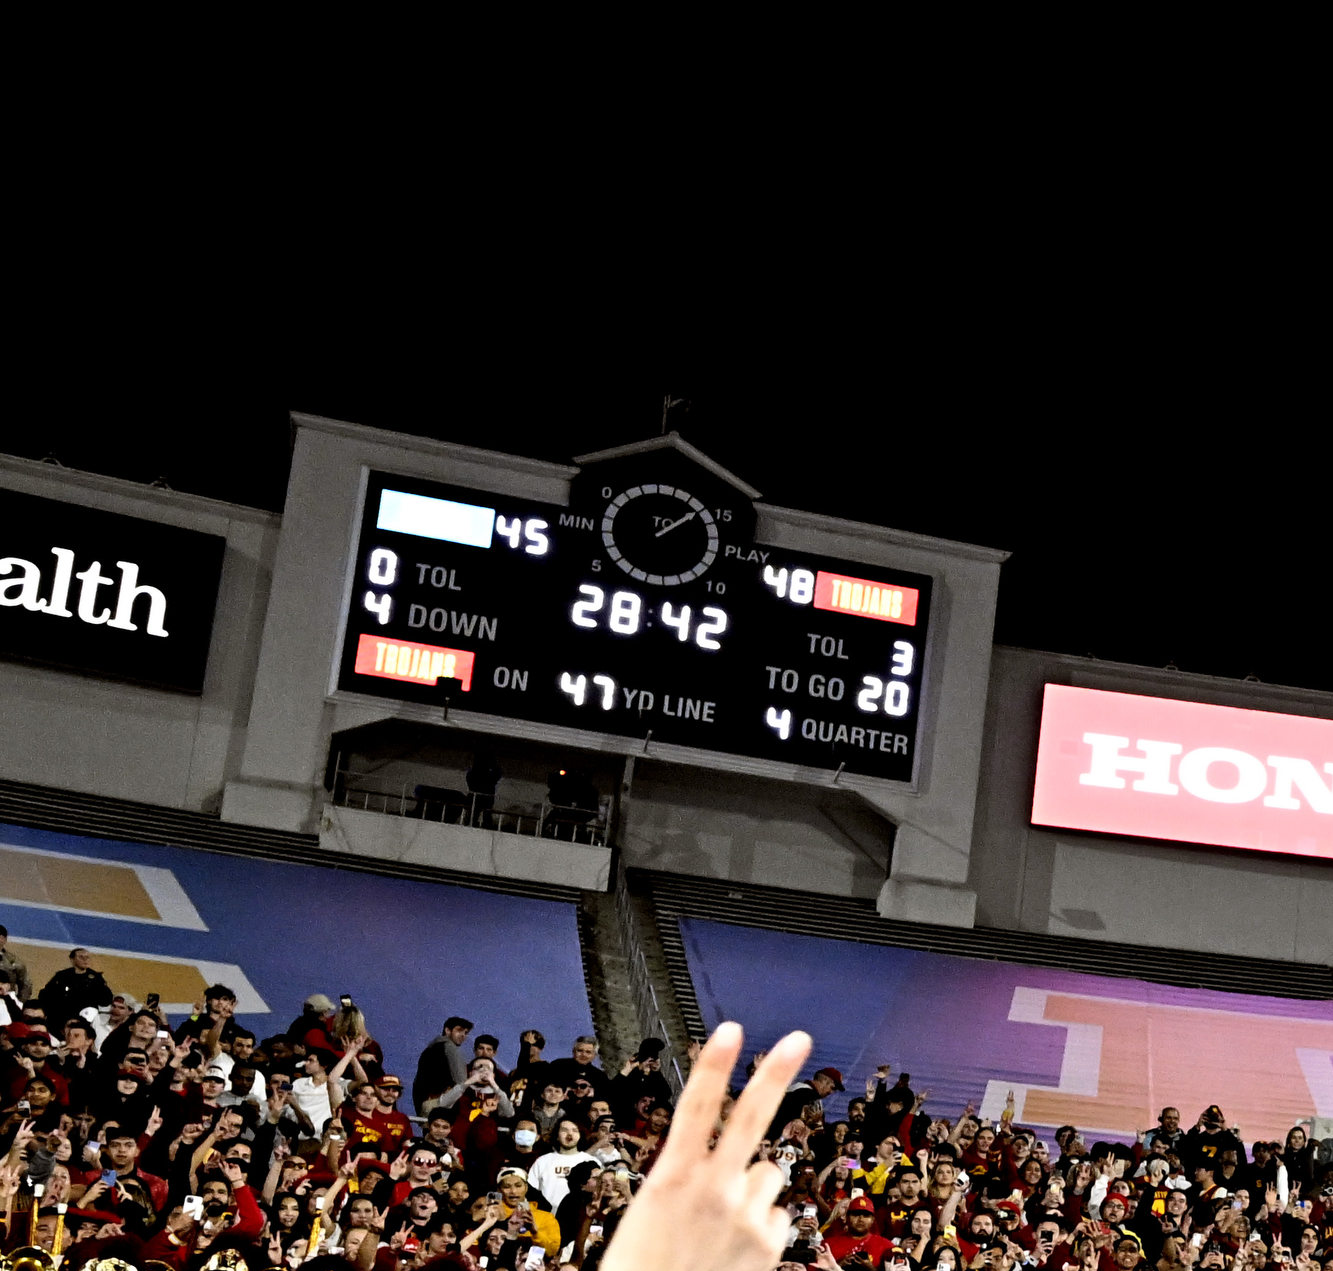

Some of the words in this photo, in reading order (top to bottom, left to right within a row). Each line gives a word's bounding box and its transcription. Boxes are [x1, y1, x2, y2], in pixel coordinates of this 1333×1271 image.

[496, 515, 549, 555] 45
[559, 513, 594, 531] MIN
[715, 508, 733, 522] 15
[368, 548, 398, 586] 0
[416, 563, 461, 591] TOL
[591, 559, 602, 572] 5
[724, 545, 770, 564] PLAY
[705, 580, 726, 594] 10
[763, 564, 814, 604] 48
[831, 578, 903, 618] TROJANS
[364, 591, 392, 625] 4
[407, 603, 498, 641] DOWN
[571, 584, 727, 650] 28:42
[807, 633, 849, 660] TOL
[891, 640, 914, 676] 3
[493, 666, 529, 691] ON
[560, 671, 615, 710] 47
[623, 687, 654, 711] YD
[662, 694, 716, 722] LINE
[766, 666, 799, 693] TO
[808, 674, 845, 702] GO
[857, 675, 910, 716] 20
[766, 706, 791, 740] 4
[801, 718, 908, 755] QUARTER
